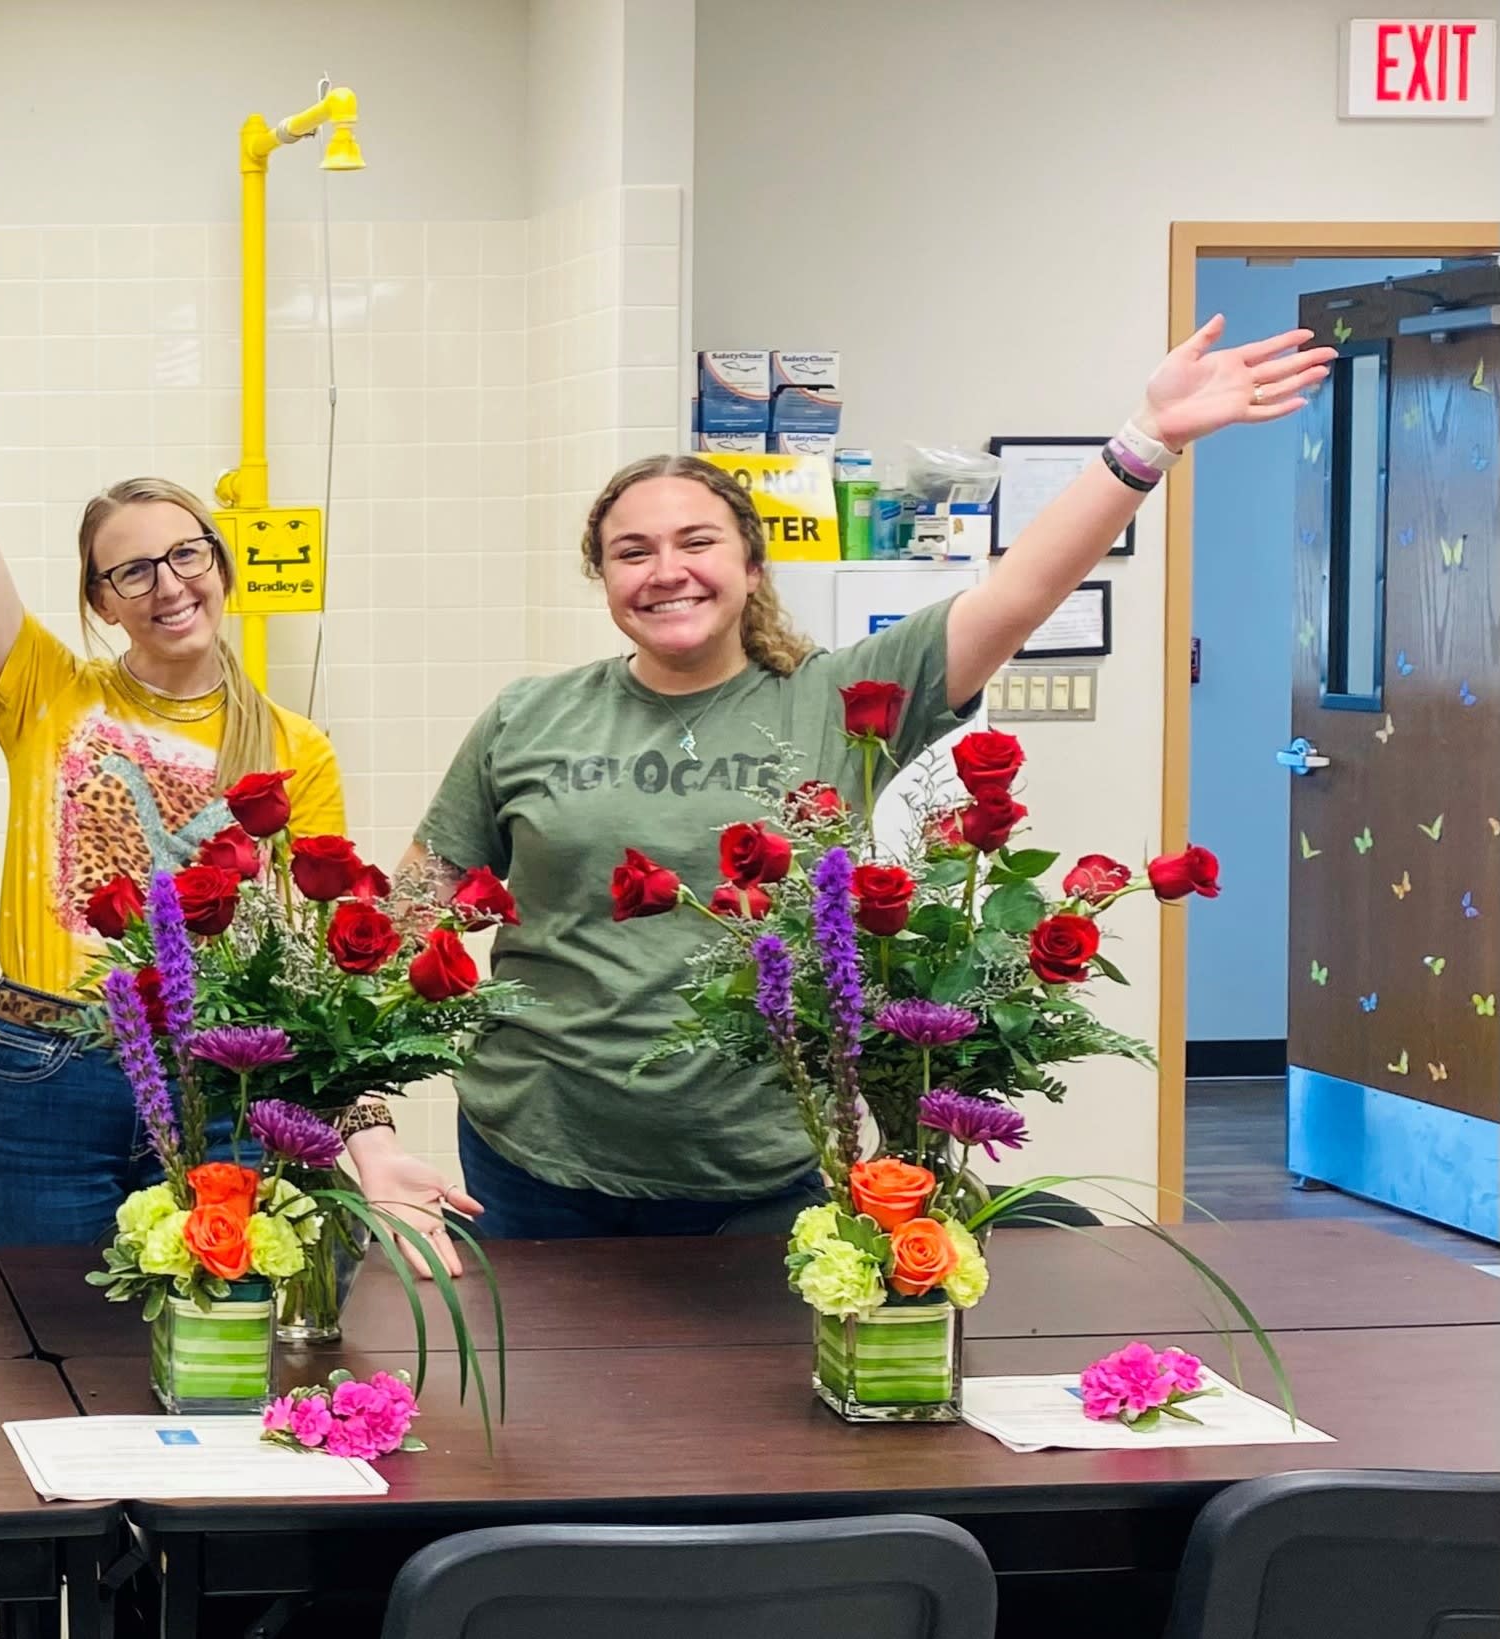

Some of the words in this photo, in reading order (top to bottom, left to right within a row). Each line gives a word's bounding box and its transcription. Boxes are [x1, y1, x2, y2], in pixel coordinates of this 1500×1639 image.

[1377, 24, 1477, 101] EXIT
[761, 516, 821, 542] TER
[247, 580, 299, 594] Bradley
